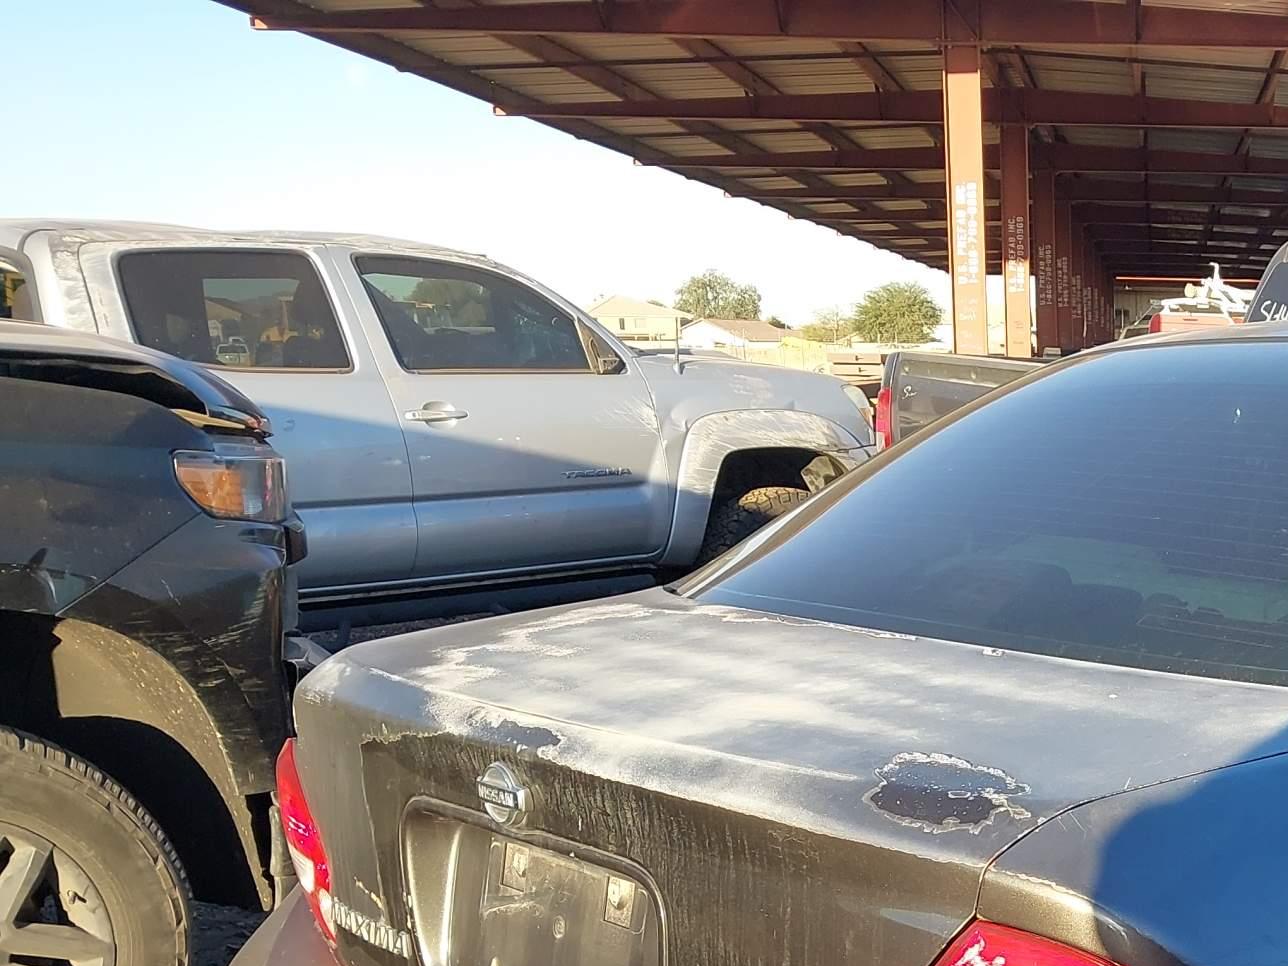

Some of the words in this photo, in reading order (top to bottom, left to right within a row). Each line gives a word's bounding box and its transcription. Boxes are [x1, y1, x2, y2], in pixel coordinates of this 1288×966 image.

[560, 467, 633, 479] TACOMA
[477, 783, 515, 808] NISSAN
[332, 896, 413, 960] MAXIMA
